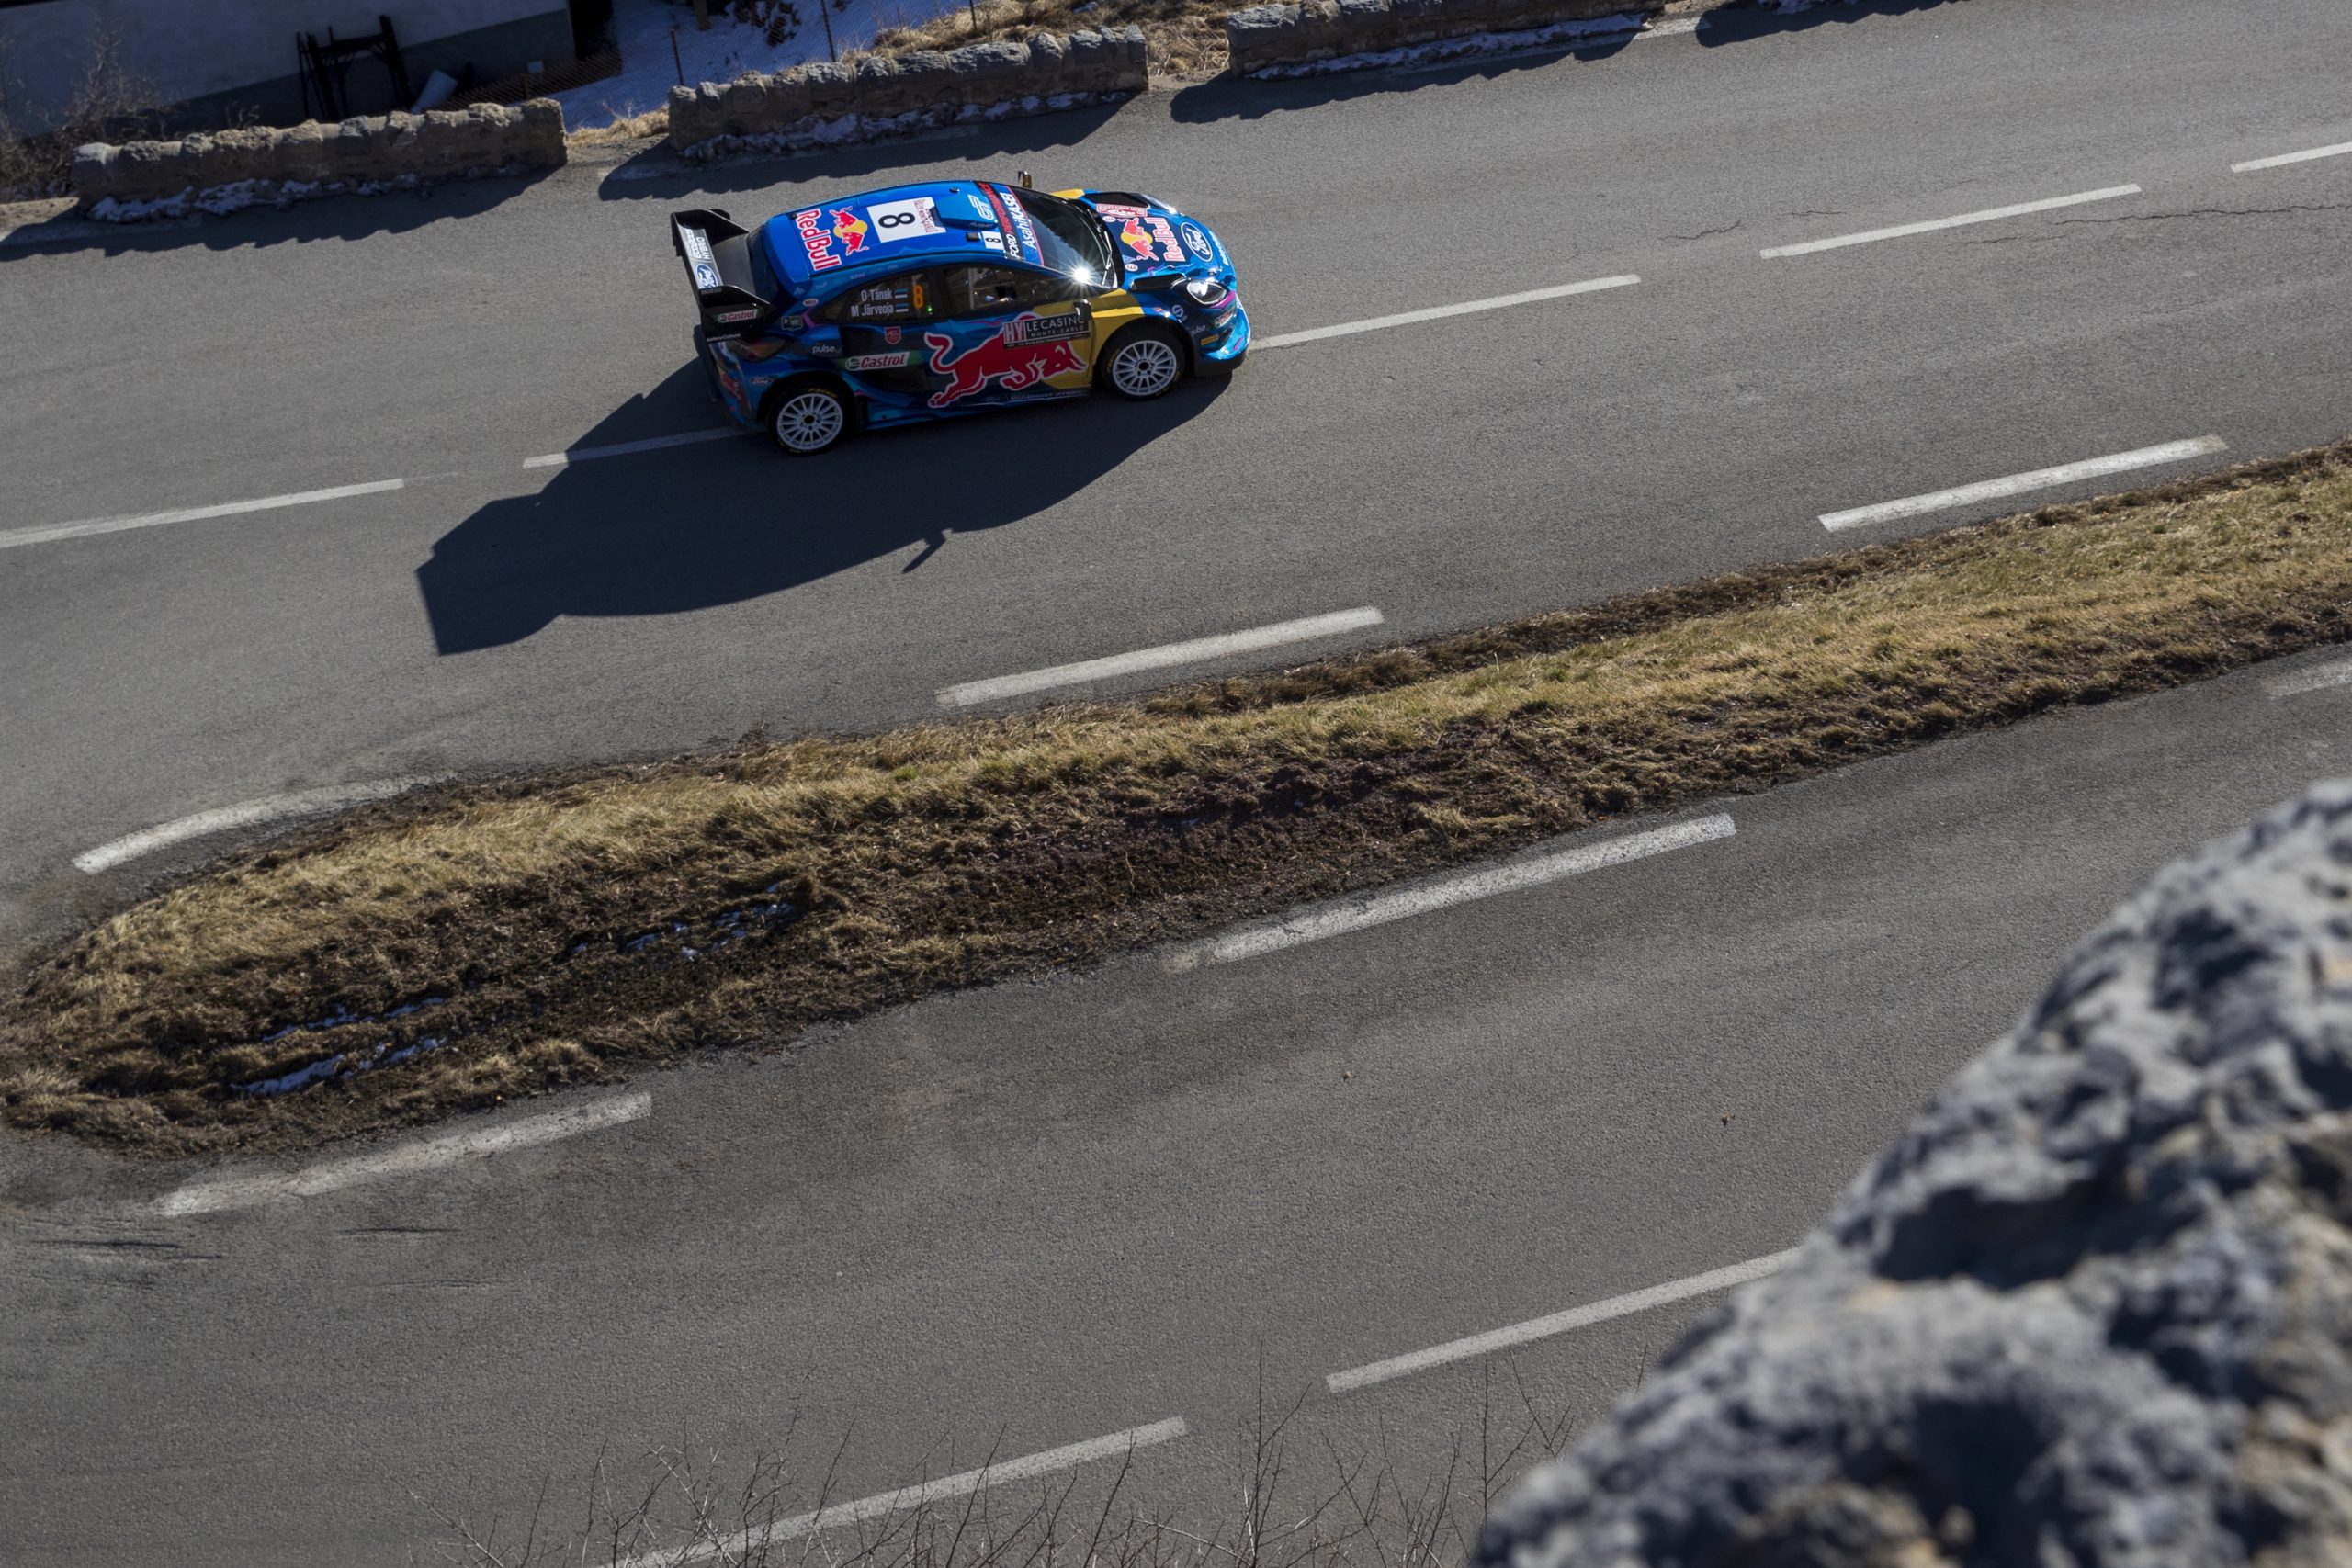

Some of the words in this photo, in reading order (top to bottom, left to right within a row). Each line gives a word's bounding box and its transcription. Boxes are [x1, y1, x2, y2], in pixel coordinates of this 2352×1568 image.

[878, 212, 915, 228] 8
[1000, 192, 1037, 249] AsahiKASEI
[1006, 233, 1021, 258] FORD
[1184, 226, 1211, 257] Ford
[861, 289, 867, 302] O
[869, 288, 892, 301] Tänak
[913, 285, 924, 309] 8
[727, 309, 754, 321] Castrol
[851, 305, 859, 317] M
[862, 303, 894, 317] Järveoja
[1005, 321, 1023, 343] HY
[1027, 321, 1038, 332] LE
[860, 354, 906, 368] Castrol
